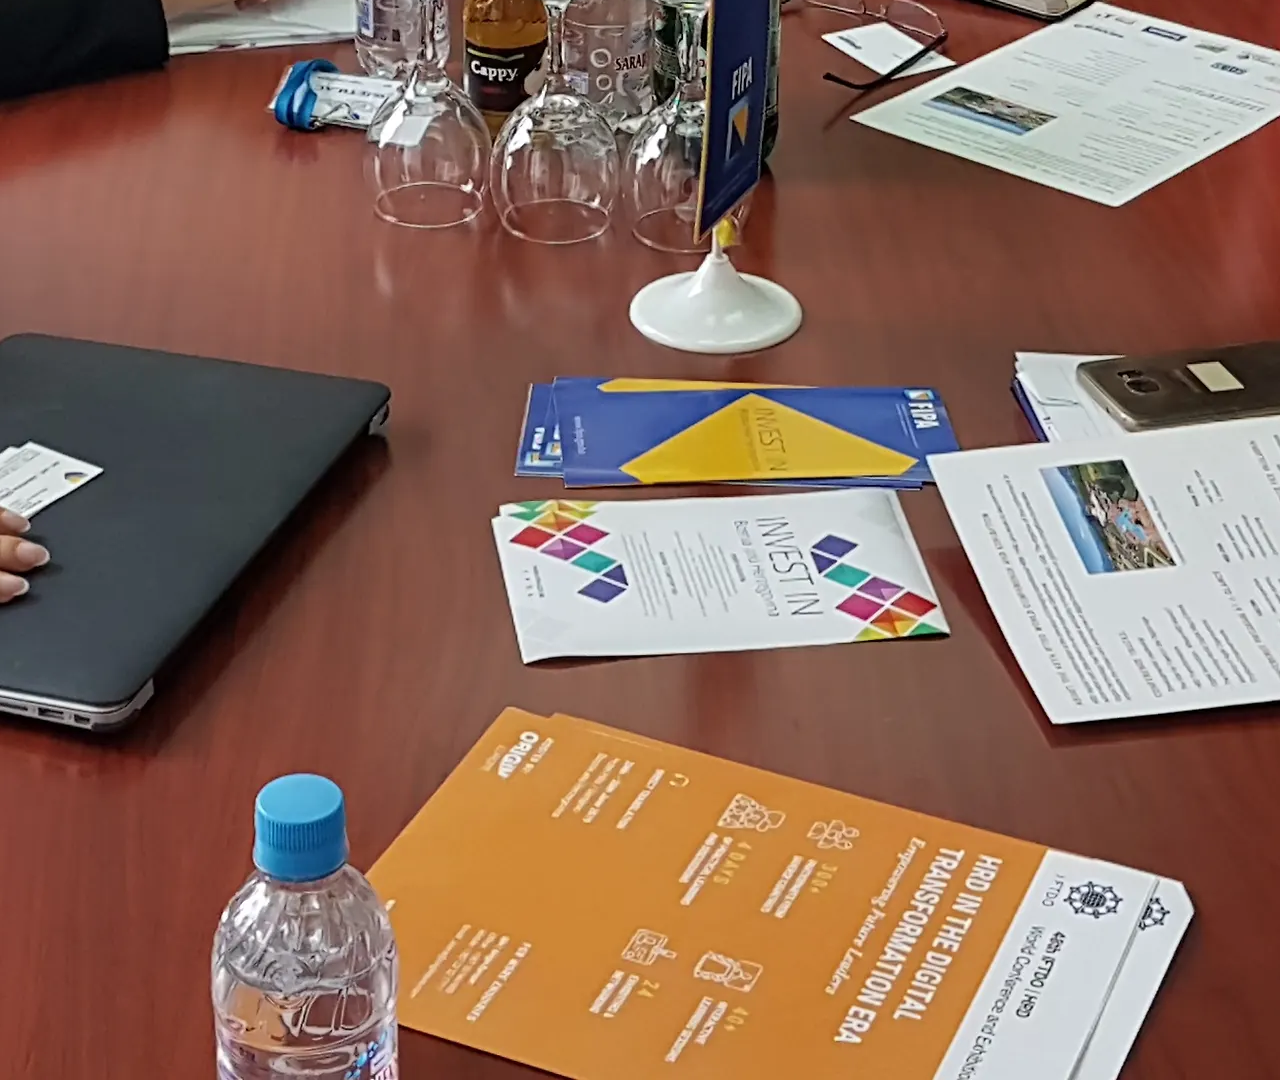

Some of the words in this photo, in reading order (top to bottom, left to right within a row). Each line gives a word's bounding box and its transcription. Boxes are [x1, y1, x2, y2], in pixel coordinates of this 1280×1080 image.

[470, 60, 518, 81] Cappy
[731, 56, 753, 100] FIPA
[756, 408, 786, 454] INVEST
[908, 402, 939, 429] FIPA
[756, 516, 814, 586] INVEST
[784, 592, 824, 615] IN
[497, 731, 539, 779] ORIGIN
[712, 851, 746, 885] DAYS
[869, 836, 925, 908] Empowering
[962, 853, 1003, 894] HRD
[951, 890, 983, 914] IN
[851, 907, 883, 947] Future
[855, 845, 964, 1008] TRANSFORMATION
[931, 914, 972, 952] THE
[824, 947, 861, 996] Leaders
[892, 950, 952, 1025] DIGITAL
[990, 954, 1029, 1014] Conference
[833, 1003, 876, 1046] ERA
